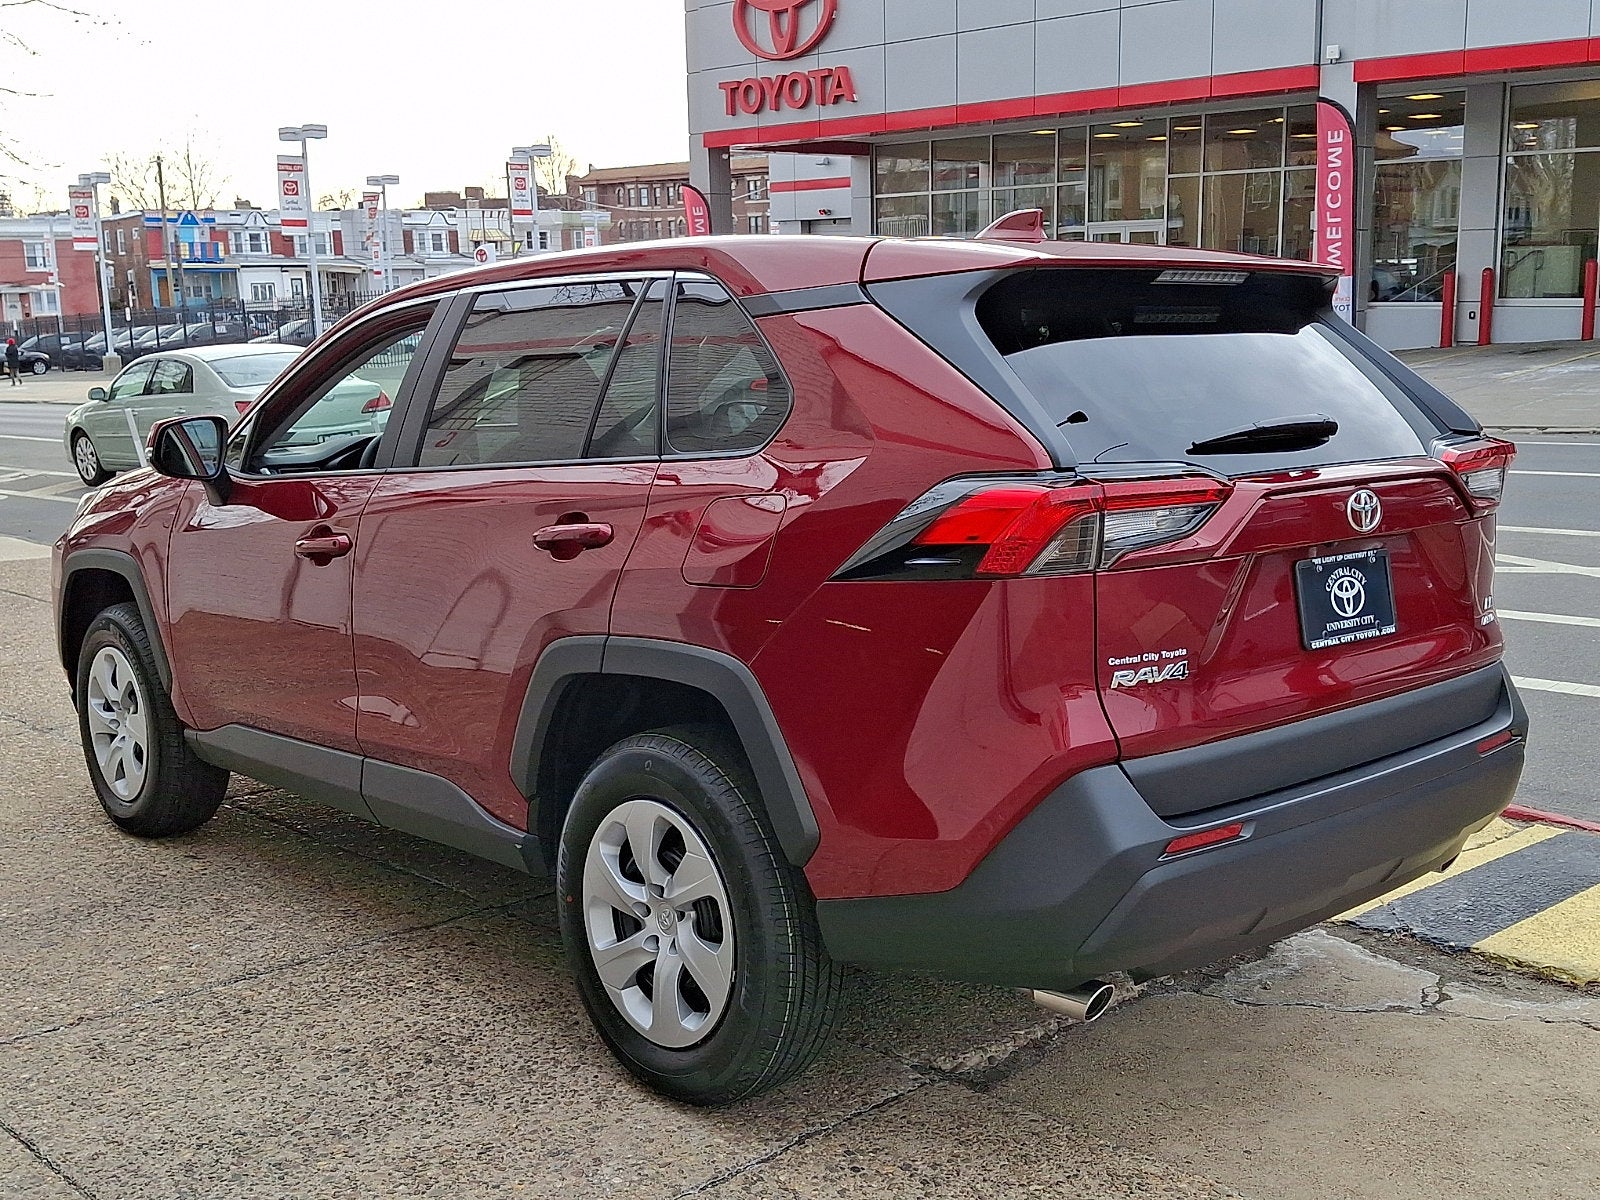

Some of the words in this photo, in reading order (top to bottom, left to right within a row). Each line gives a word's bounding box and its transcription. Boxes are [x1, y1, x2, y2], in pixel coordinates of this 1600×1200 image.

[718, 66, 858, 117] TOYOTA
[1325, 566, 1350, 592] CENTRAL
[1350, 568, 1367, 585] CITY
[1326, 617, 1361, 631] UNIVERSITY
[1360, 615, 1375, 625] CITY
[1311, 637, 1340, 649] CENTRAL
[1340, 634, 1356, 643] CITY
[1355, 630, 1380, 641] TOYOTA
[1108, 655, 1141, 666] Central
[1142, 652, 1160, 662] City
[1160, 648, 1187, 659] Toyota
[1110, 660, 1190, 690] RAV4
